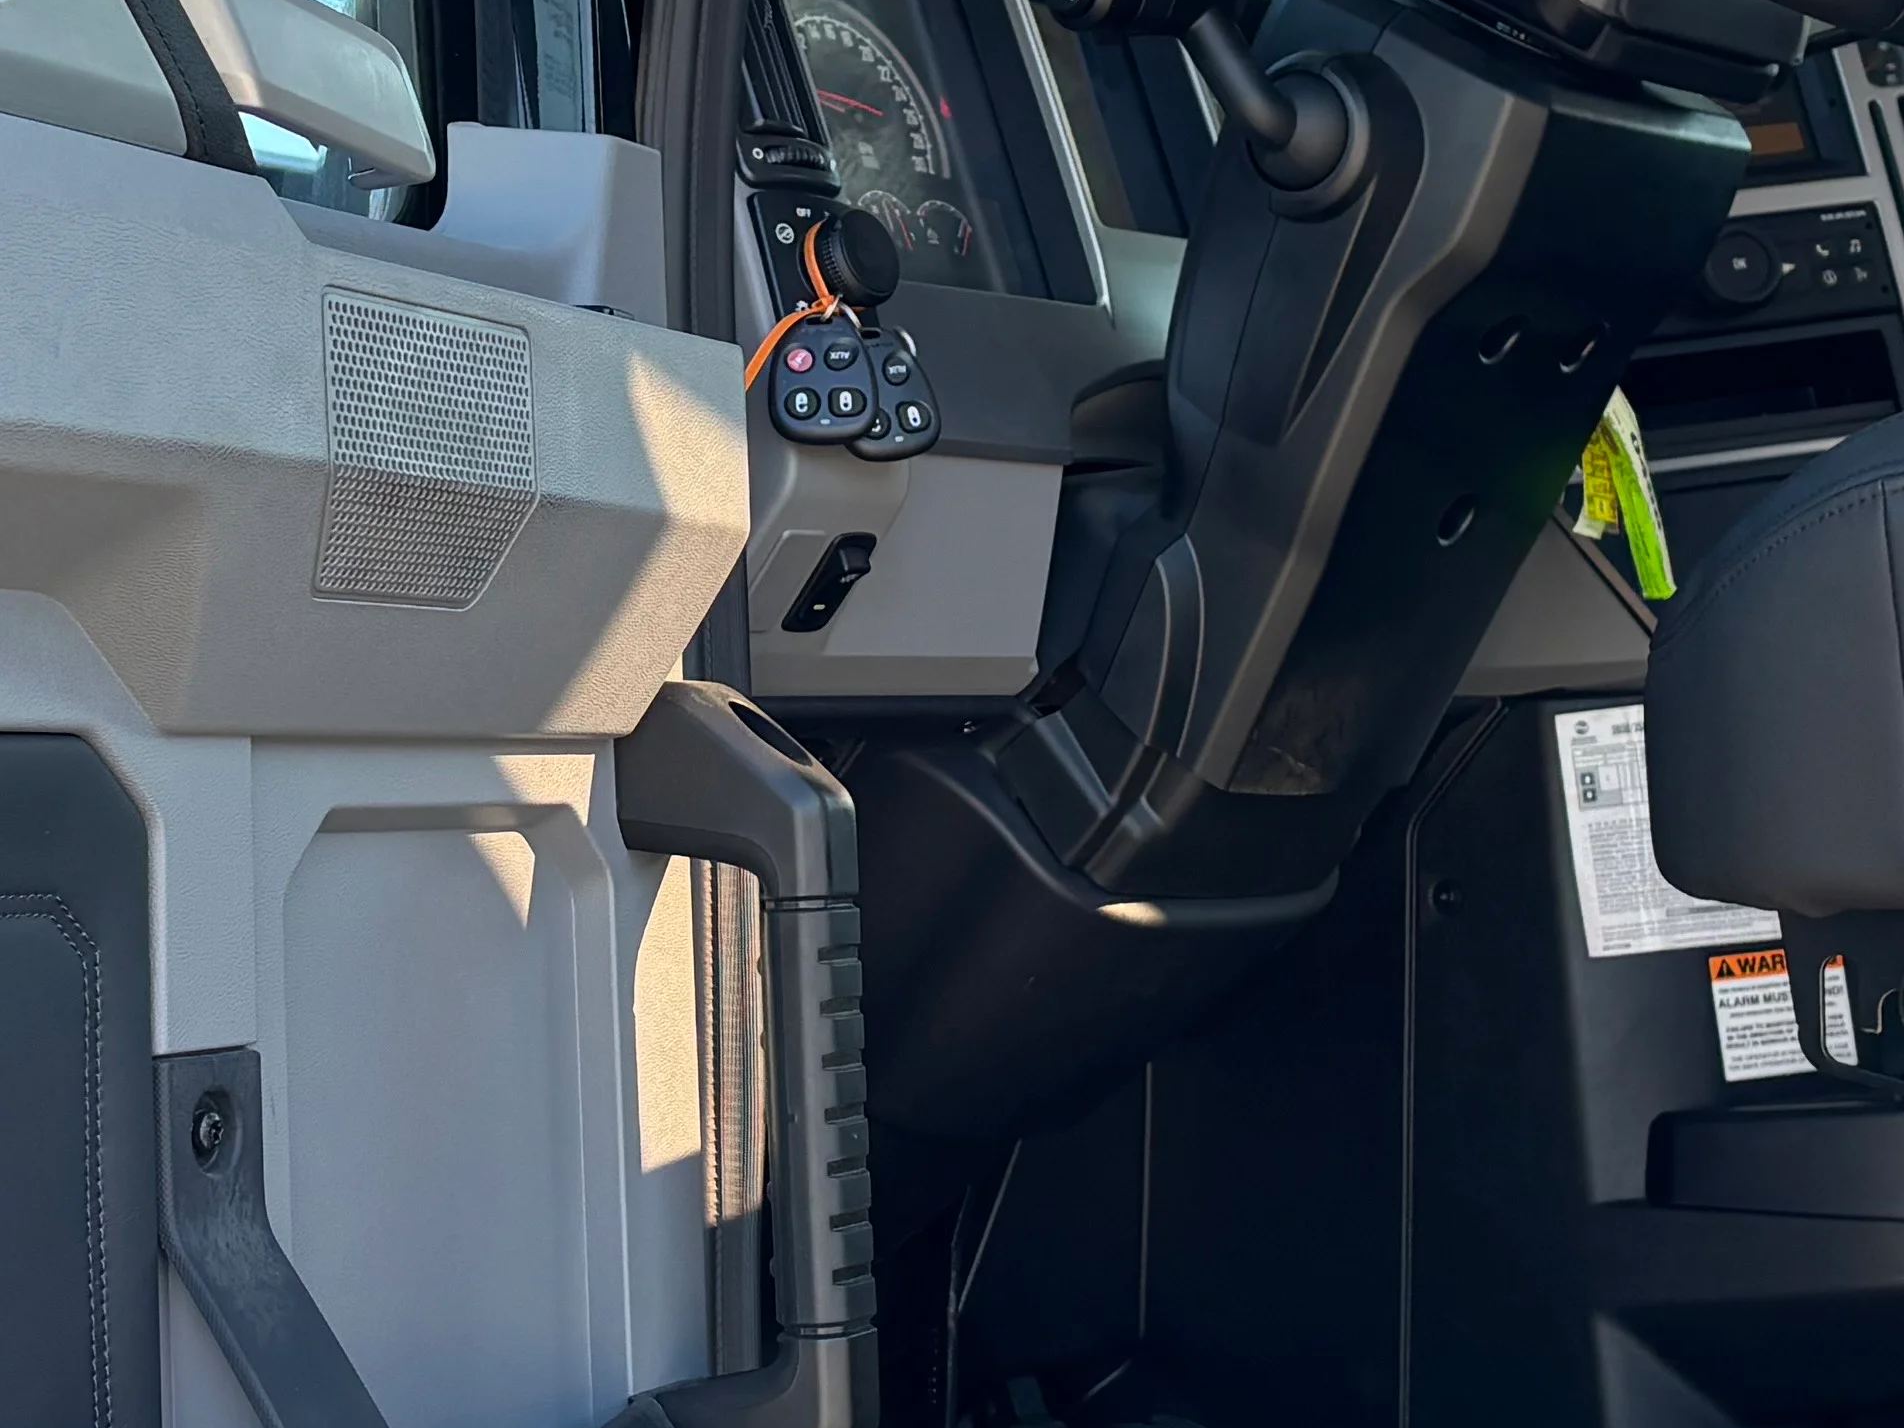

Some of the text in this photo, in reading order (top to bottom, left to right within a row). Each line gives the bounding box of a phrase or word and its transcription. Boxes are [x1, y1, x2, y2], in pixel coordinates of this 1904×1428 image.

[1732, 257, 1747, 270] OK
[829, 351, 850, 360] AUX
[1719, 991, 1789, 1009] ALARM MUS
